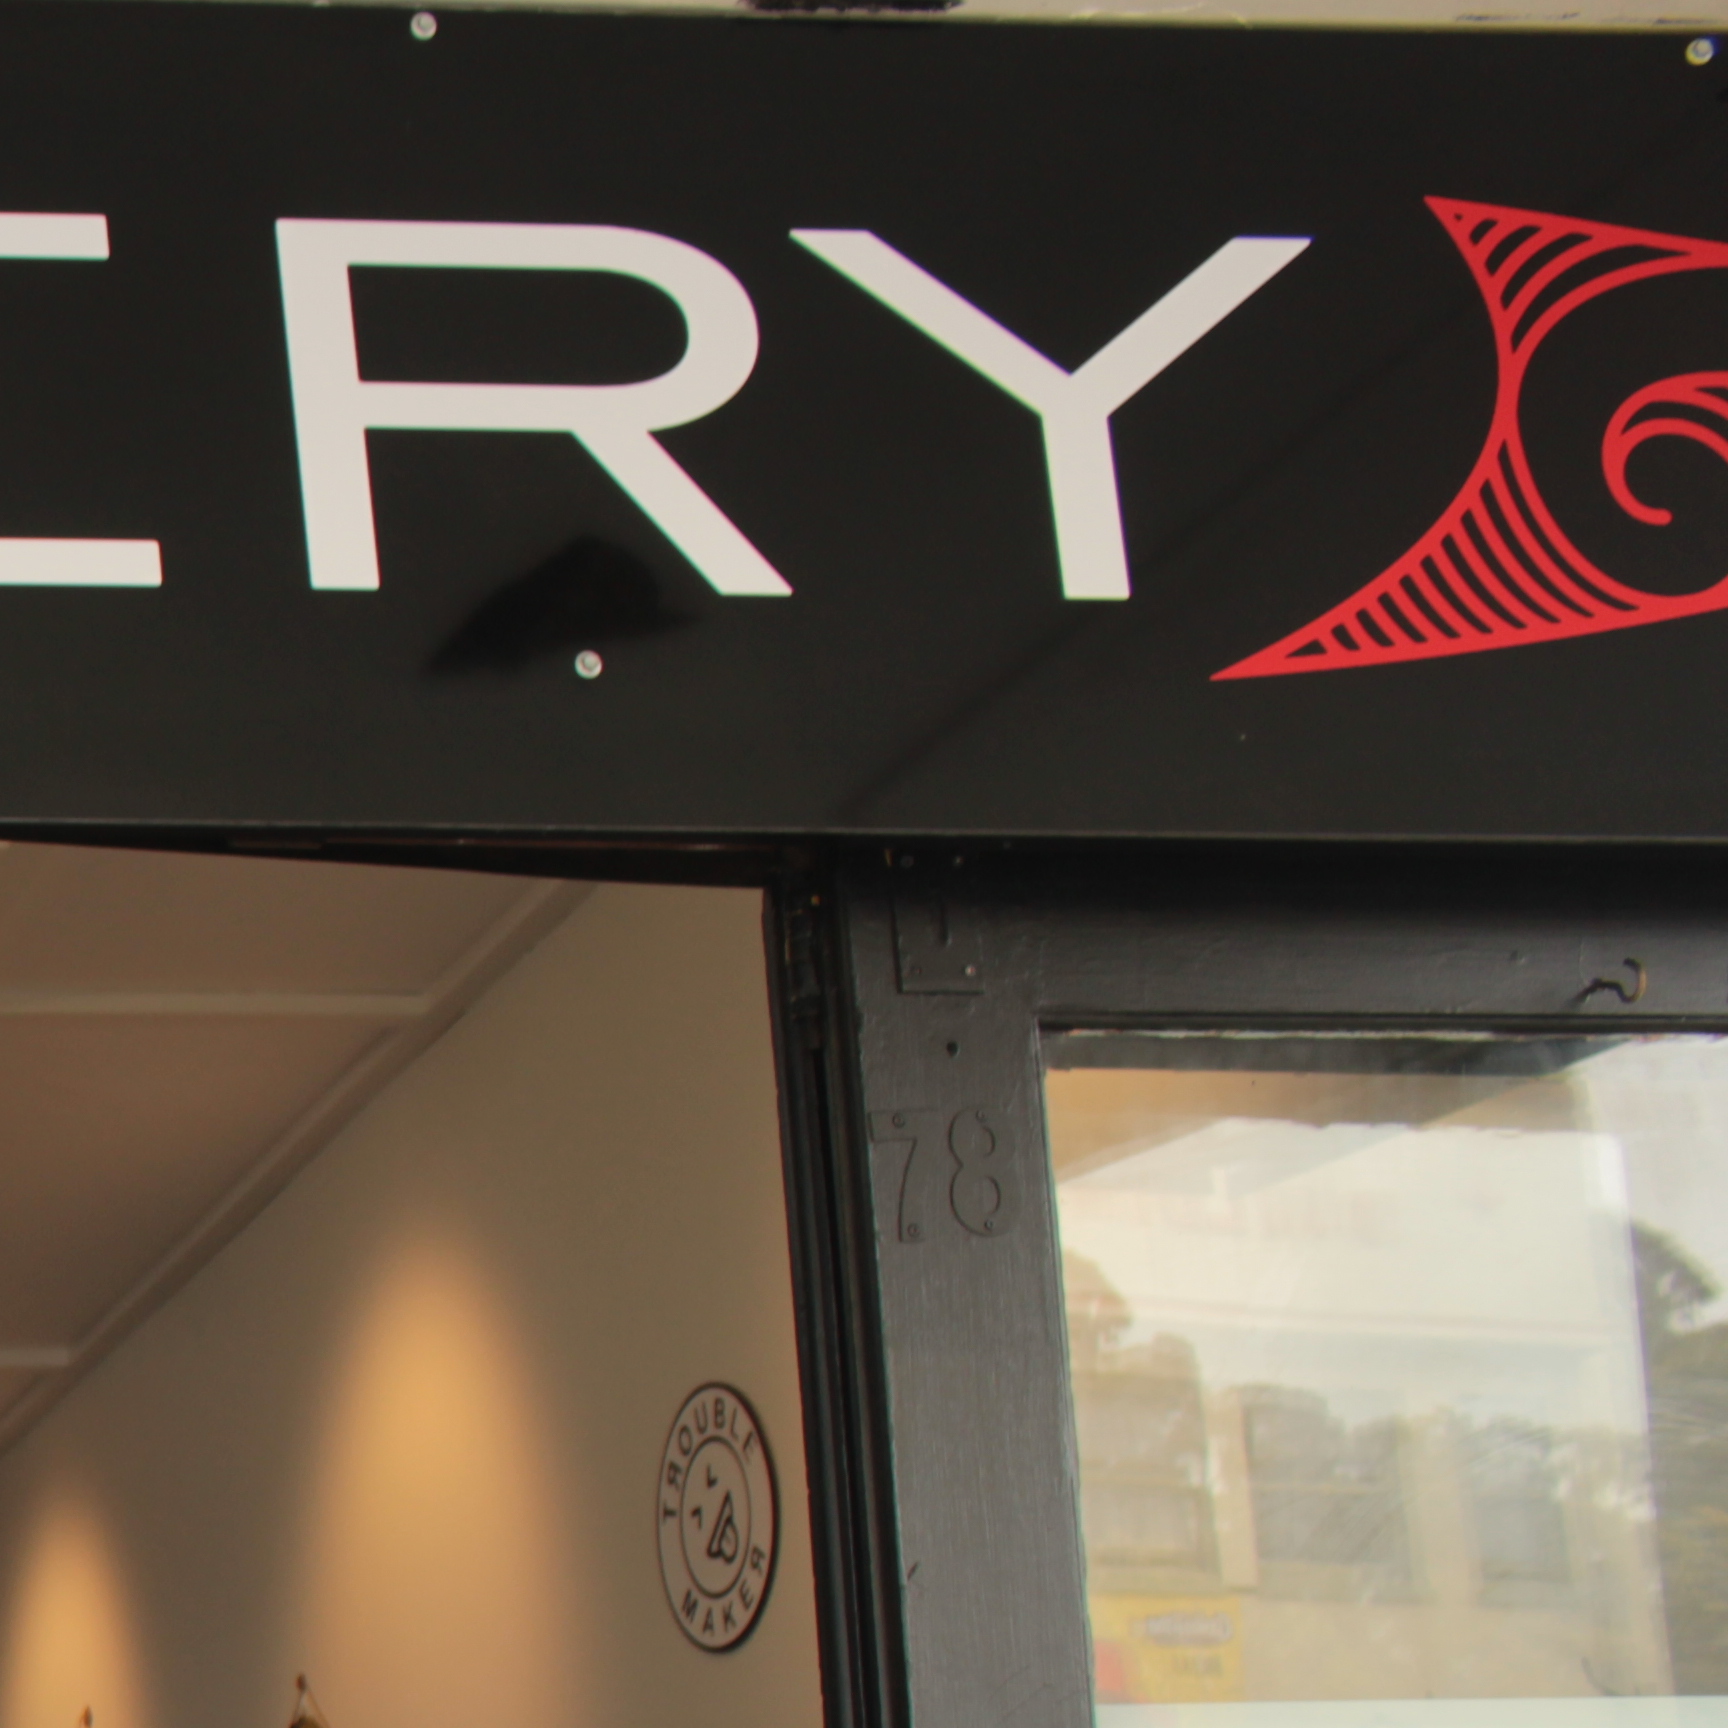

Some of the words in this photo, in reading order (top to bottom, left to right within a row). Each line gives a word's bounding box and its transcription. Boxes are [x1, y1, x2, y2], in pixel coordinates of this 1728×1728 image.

[867, 1106, 1024, 1244] 78
[661, 1396, 760, 1527] TROUBLE
[681, 1544, 767, 1637] MAKER
